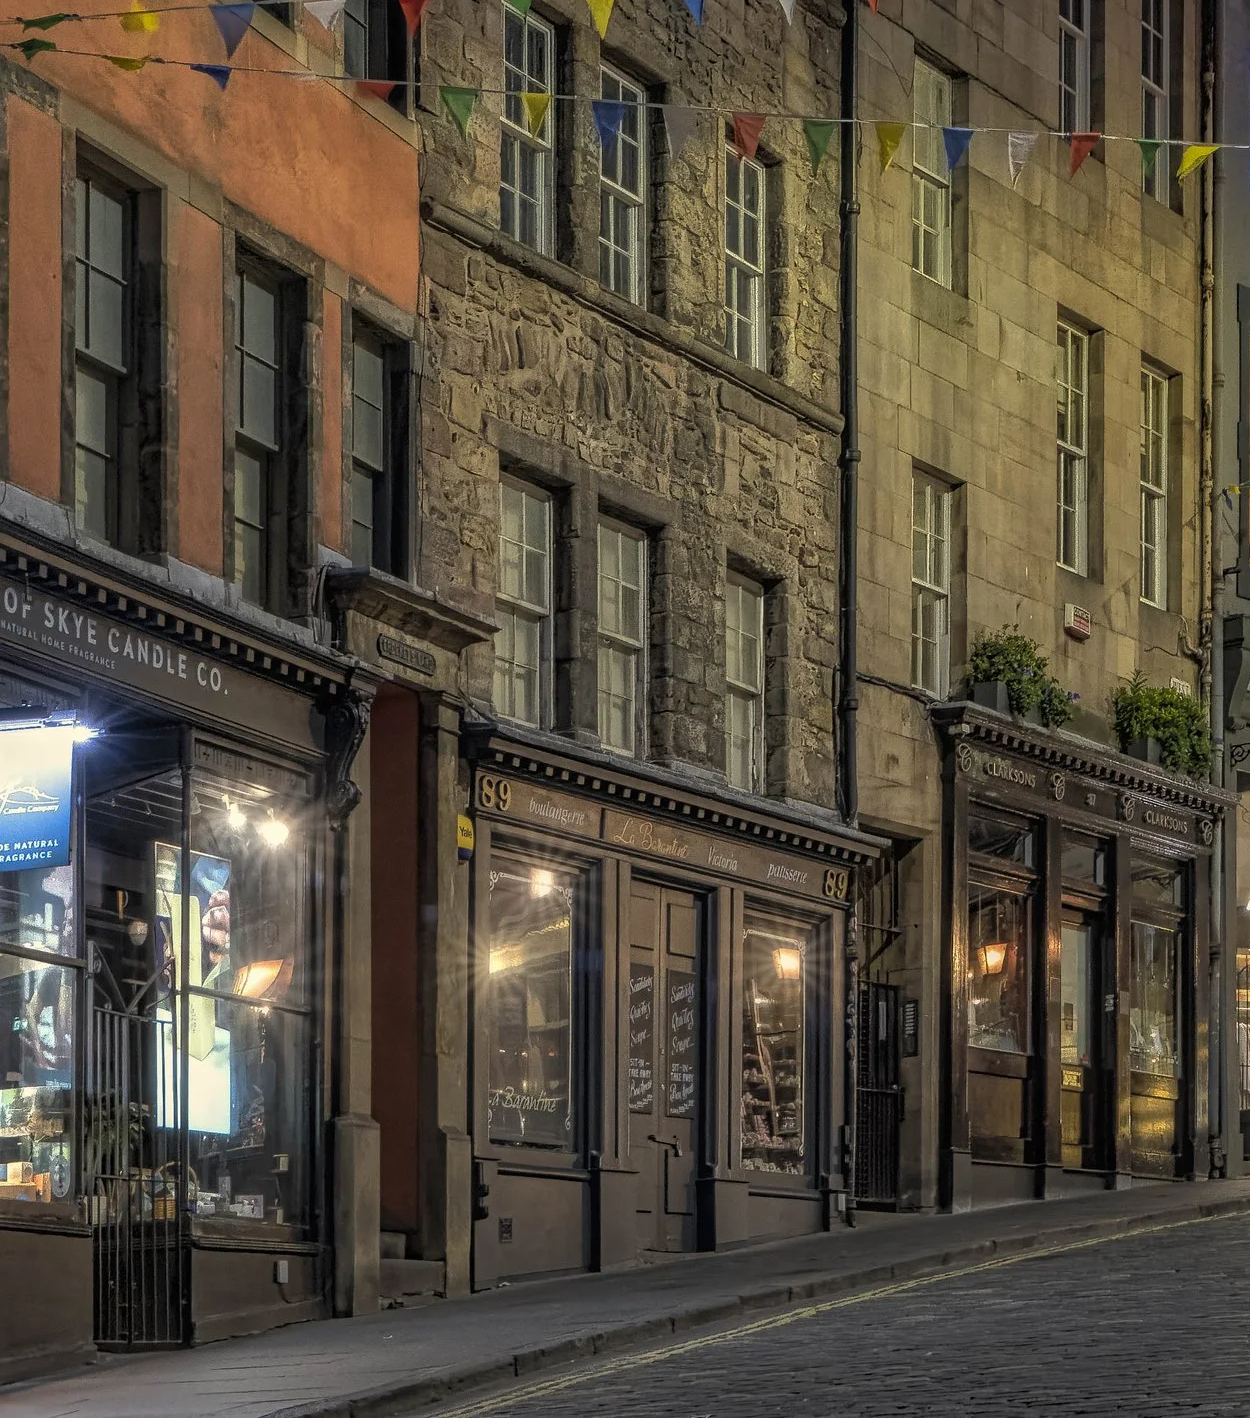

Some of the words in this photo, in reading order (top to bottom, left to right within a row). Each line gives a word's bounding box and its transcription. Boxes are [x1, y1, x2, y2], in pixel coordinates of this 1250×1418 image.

[1, 620, 37, 642] NATURAL
[41, 633, 65, 651] HOME
[69, 644, 116, 670] FRAGRANCE
[4, 587, 31, 618] OF
[44, 602, 97, 645] SKYE
[108, 628, 187, 679] CANDLE
[197, 662, 228, 695] CO.
[986, 762, 1036, 789] CLARKSONS
[482, 776, 512, 812] 89
[528, 796, 586, 827] boulangerie
[1146, 810, 1188, 834] CLARKSONS
[14, 839, 59, 850] NATURAL
[459, 825, 473, 839] Yale
[613, 817, 636, 845] La
[706, 845, 738, 873] Victoria
[766, 863, 808, 885] patisserie
[823, 869, 849, 899] 89
